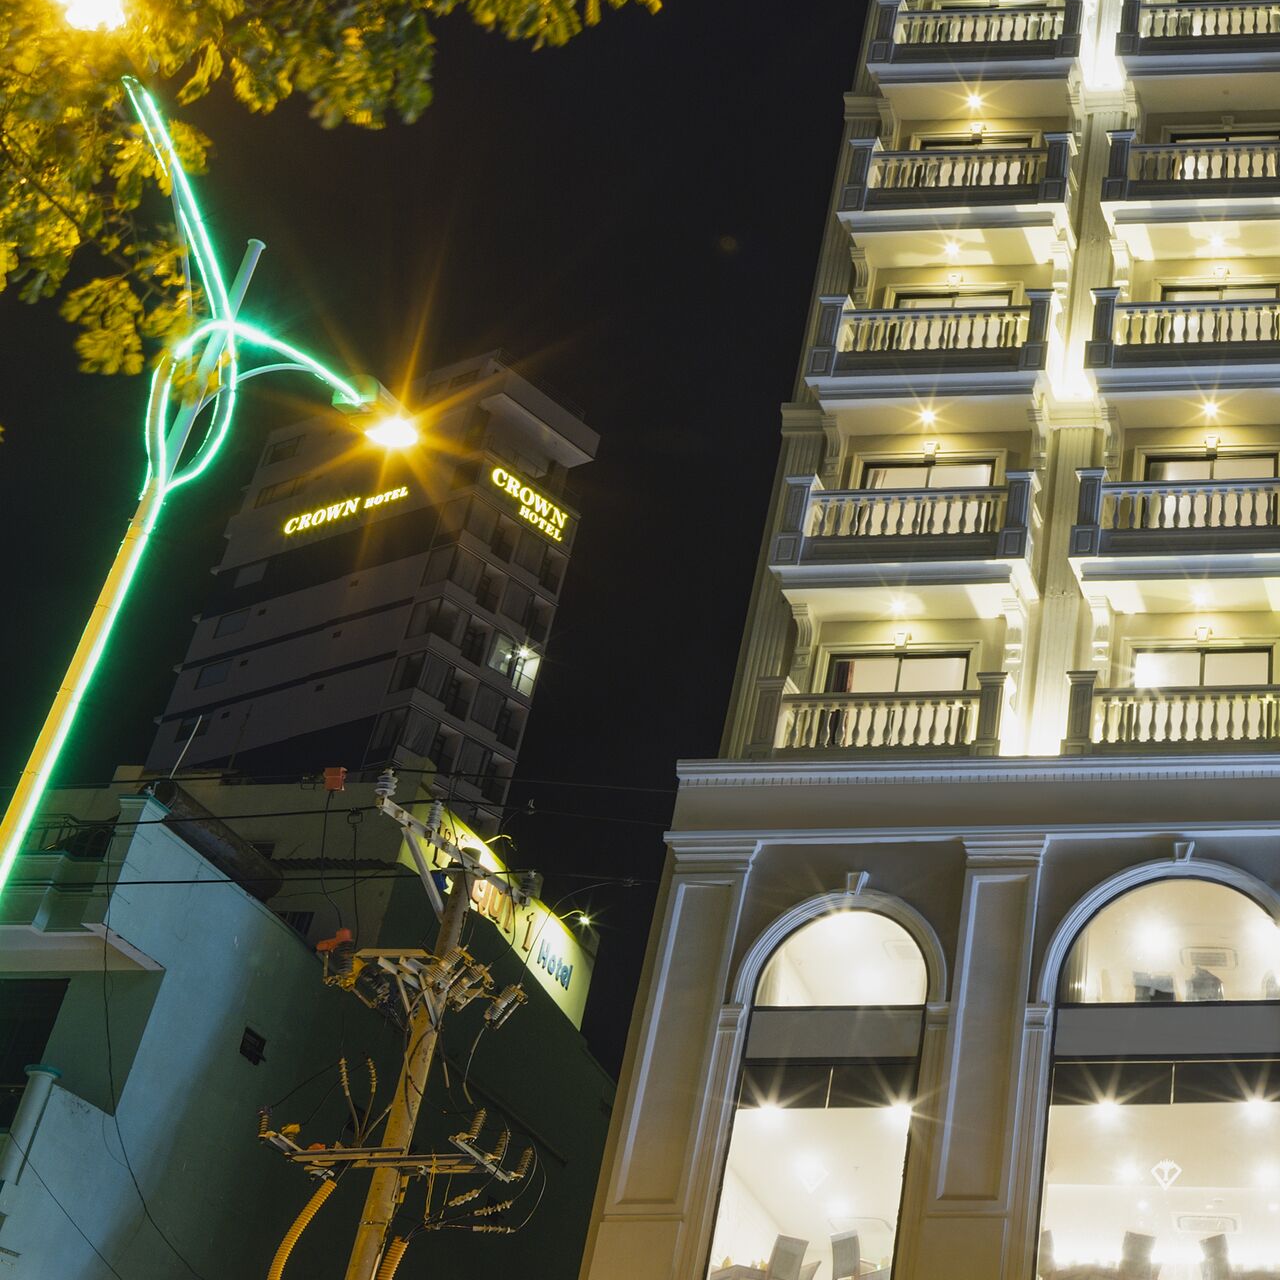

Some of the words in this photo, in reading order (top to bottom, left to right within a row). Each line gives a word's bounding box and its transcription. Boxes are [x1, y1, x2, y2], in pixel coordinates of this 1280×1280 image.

[283, 497, 361, 535] CROWN
[363, 486, 409, 509] HOTEL
[492, 467, 569, 529] CROWN
[519, 504, 562, 541] HOTEL
[536, 937, 574, 992] Hotel
